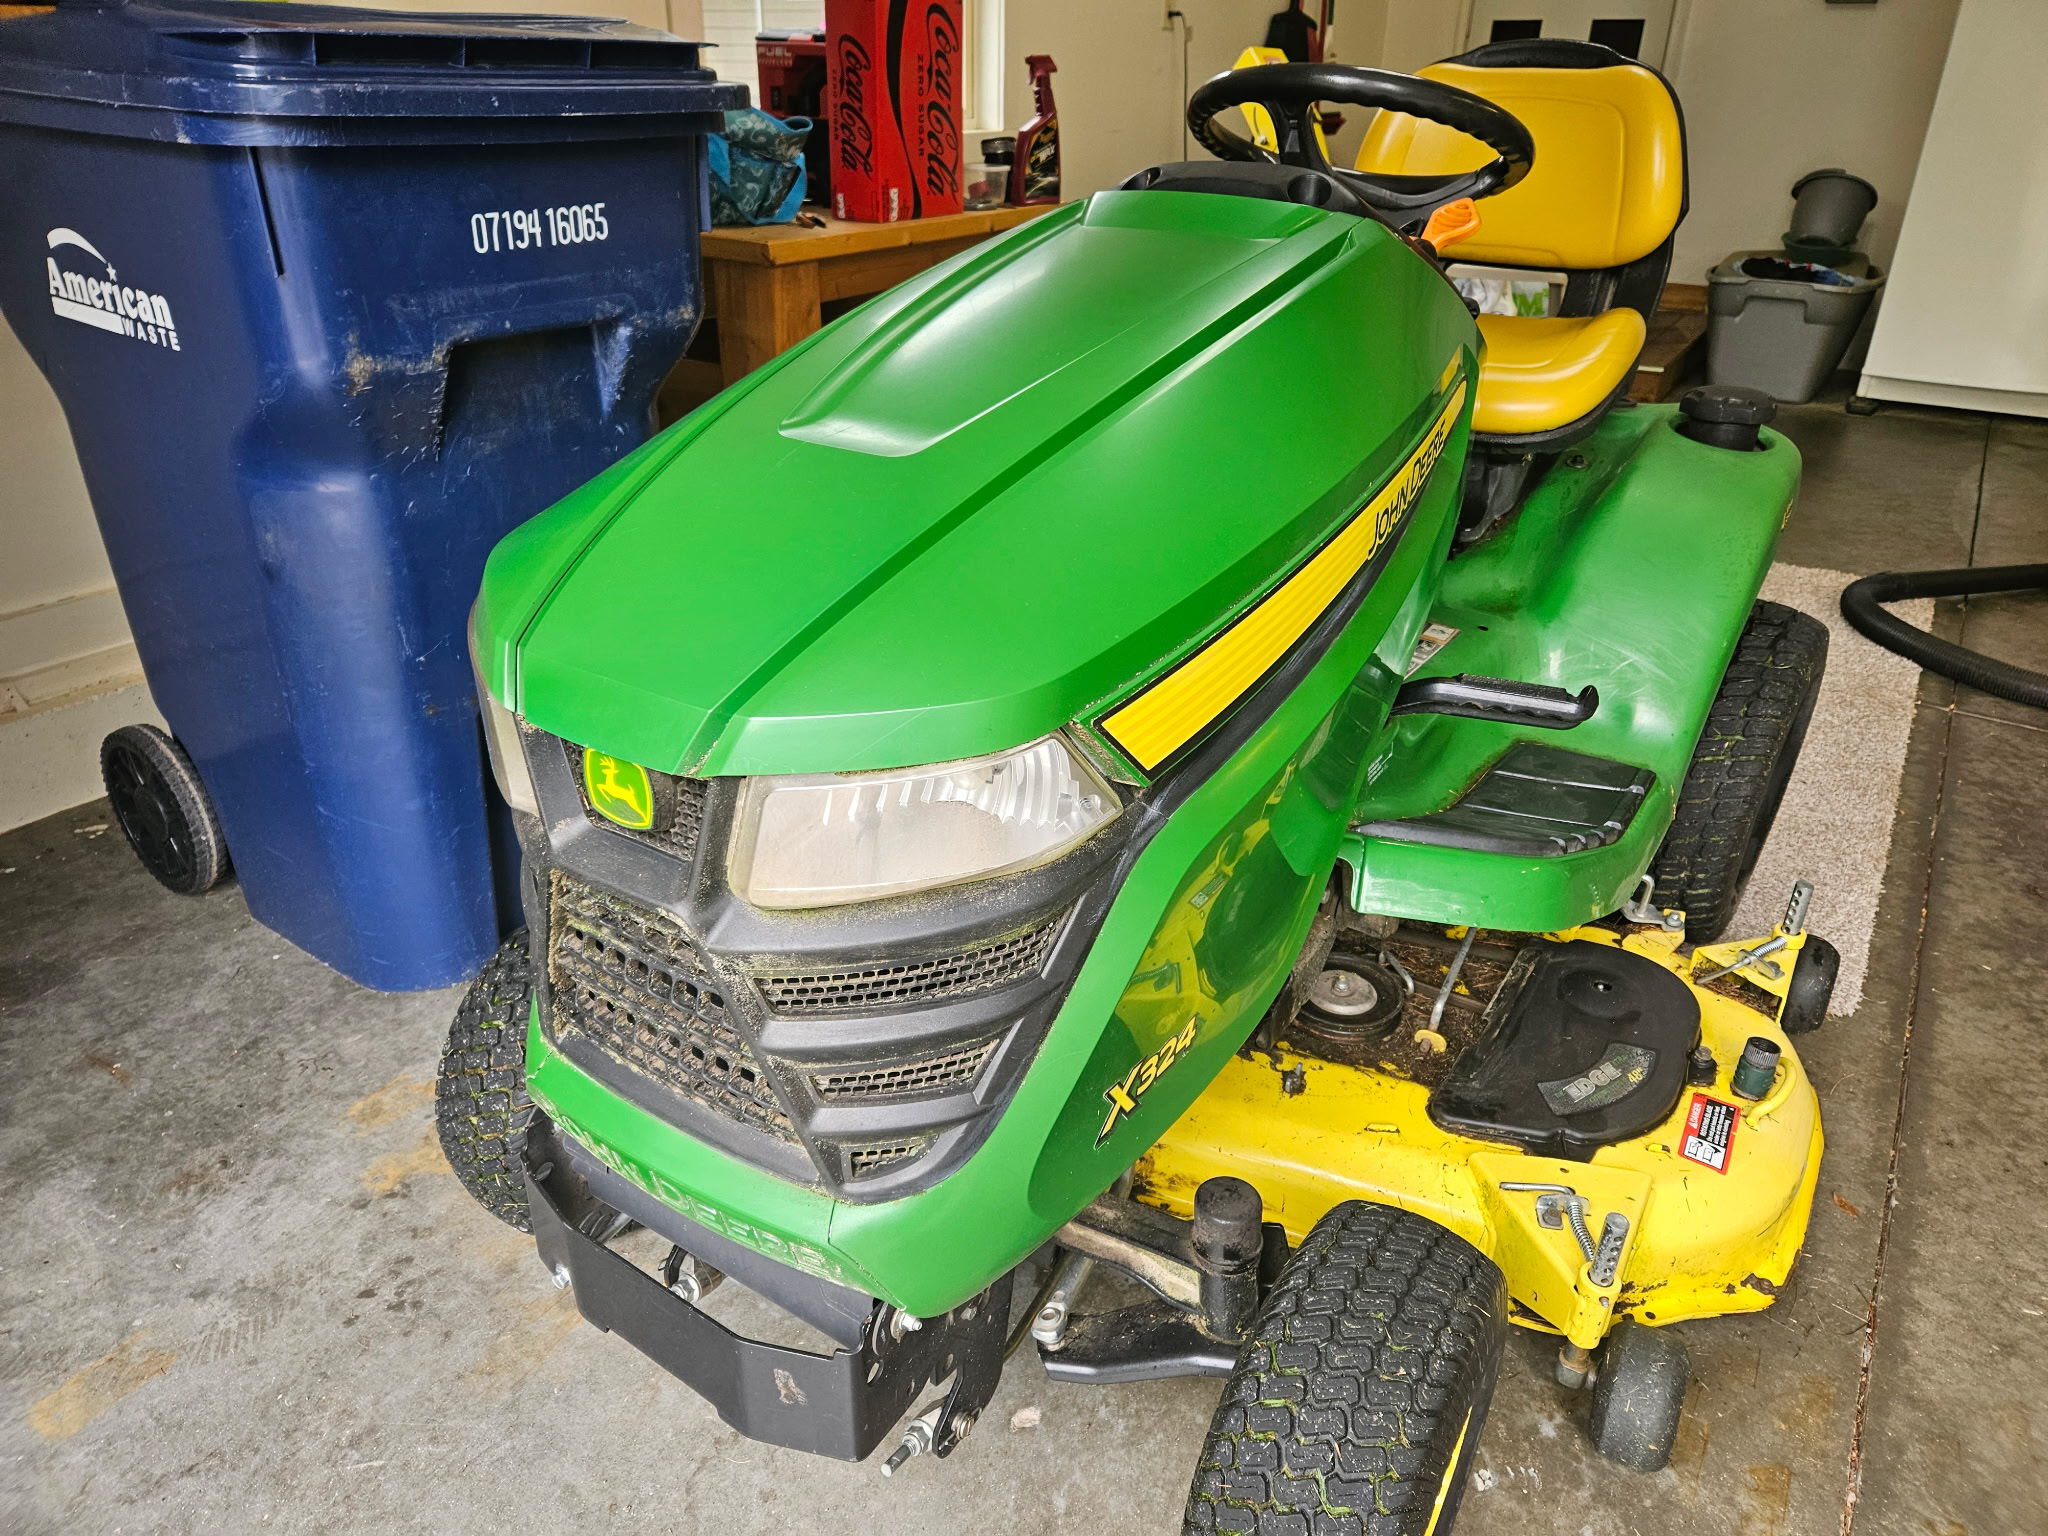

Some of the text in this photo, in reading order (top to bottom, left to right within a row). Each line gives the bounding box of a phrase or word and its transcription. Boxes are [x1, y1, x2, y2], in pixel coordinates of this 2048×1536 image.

[758, 47, 792, 57] FUEL
[917, 53, 925, 157] ZERO SUGAR
[471, 202, 609, 254] 07194 16065
[46, 256, 175, 330] American
[121, 317, 181, 352] WASTE
[1367, 418, 1446, 560] JOHN DEERE
[1095, 1012, 1199, 1149] X324
[1562, 1061, 1622, 1103] EDGE
[1689, 1102, 1703, 1123] DANGER
